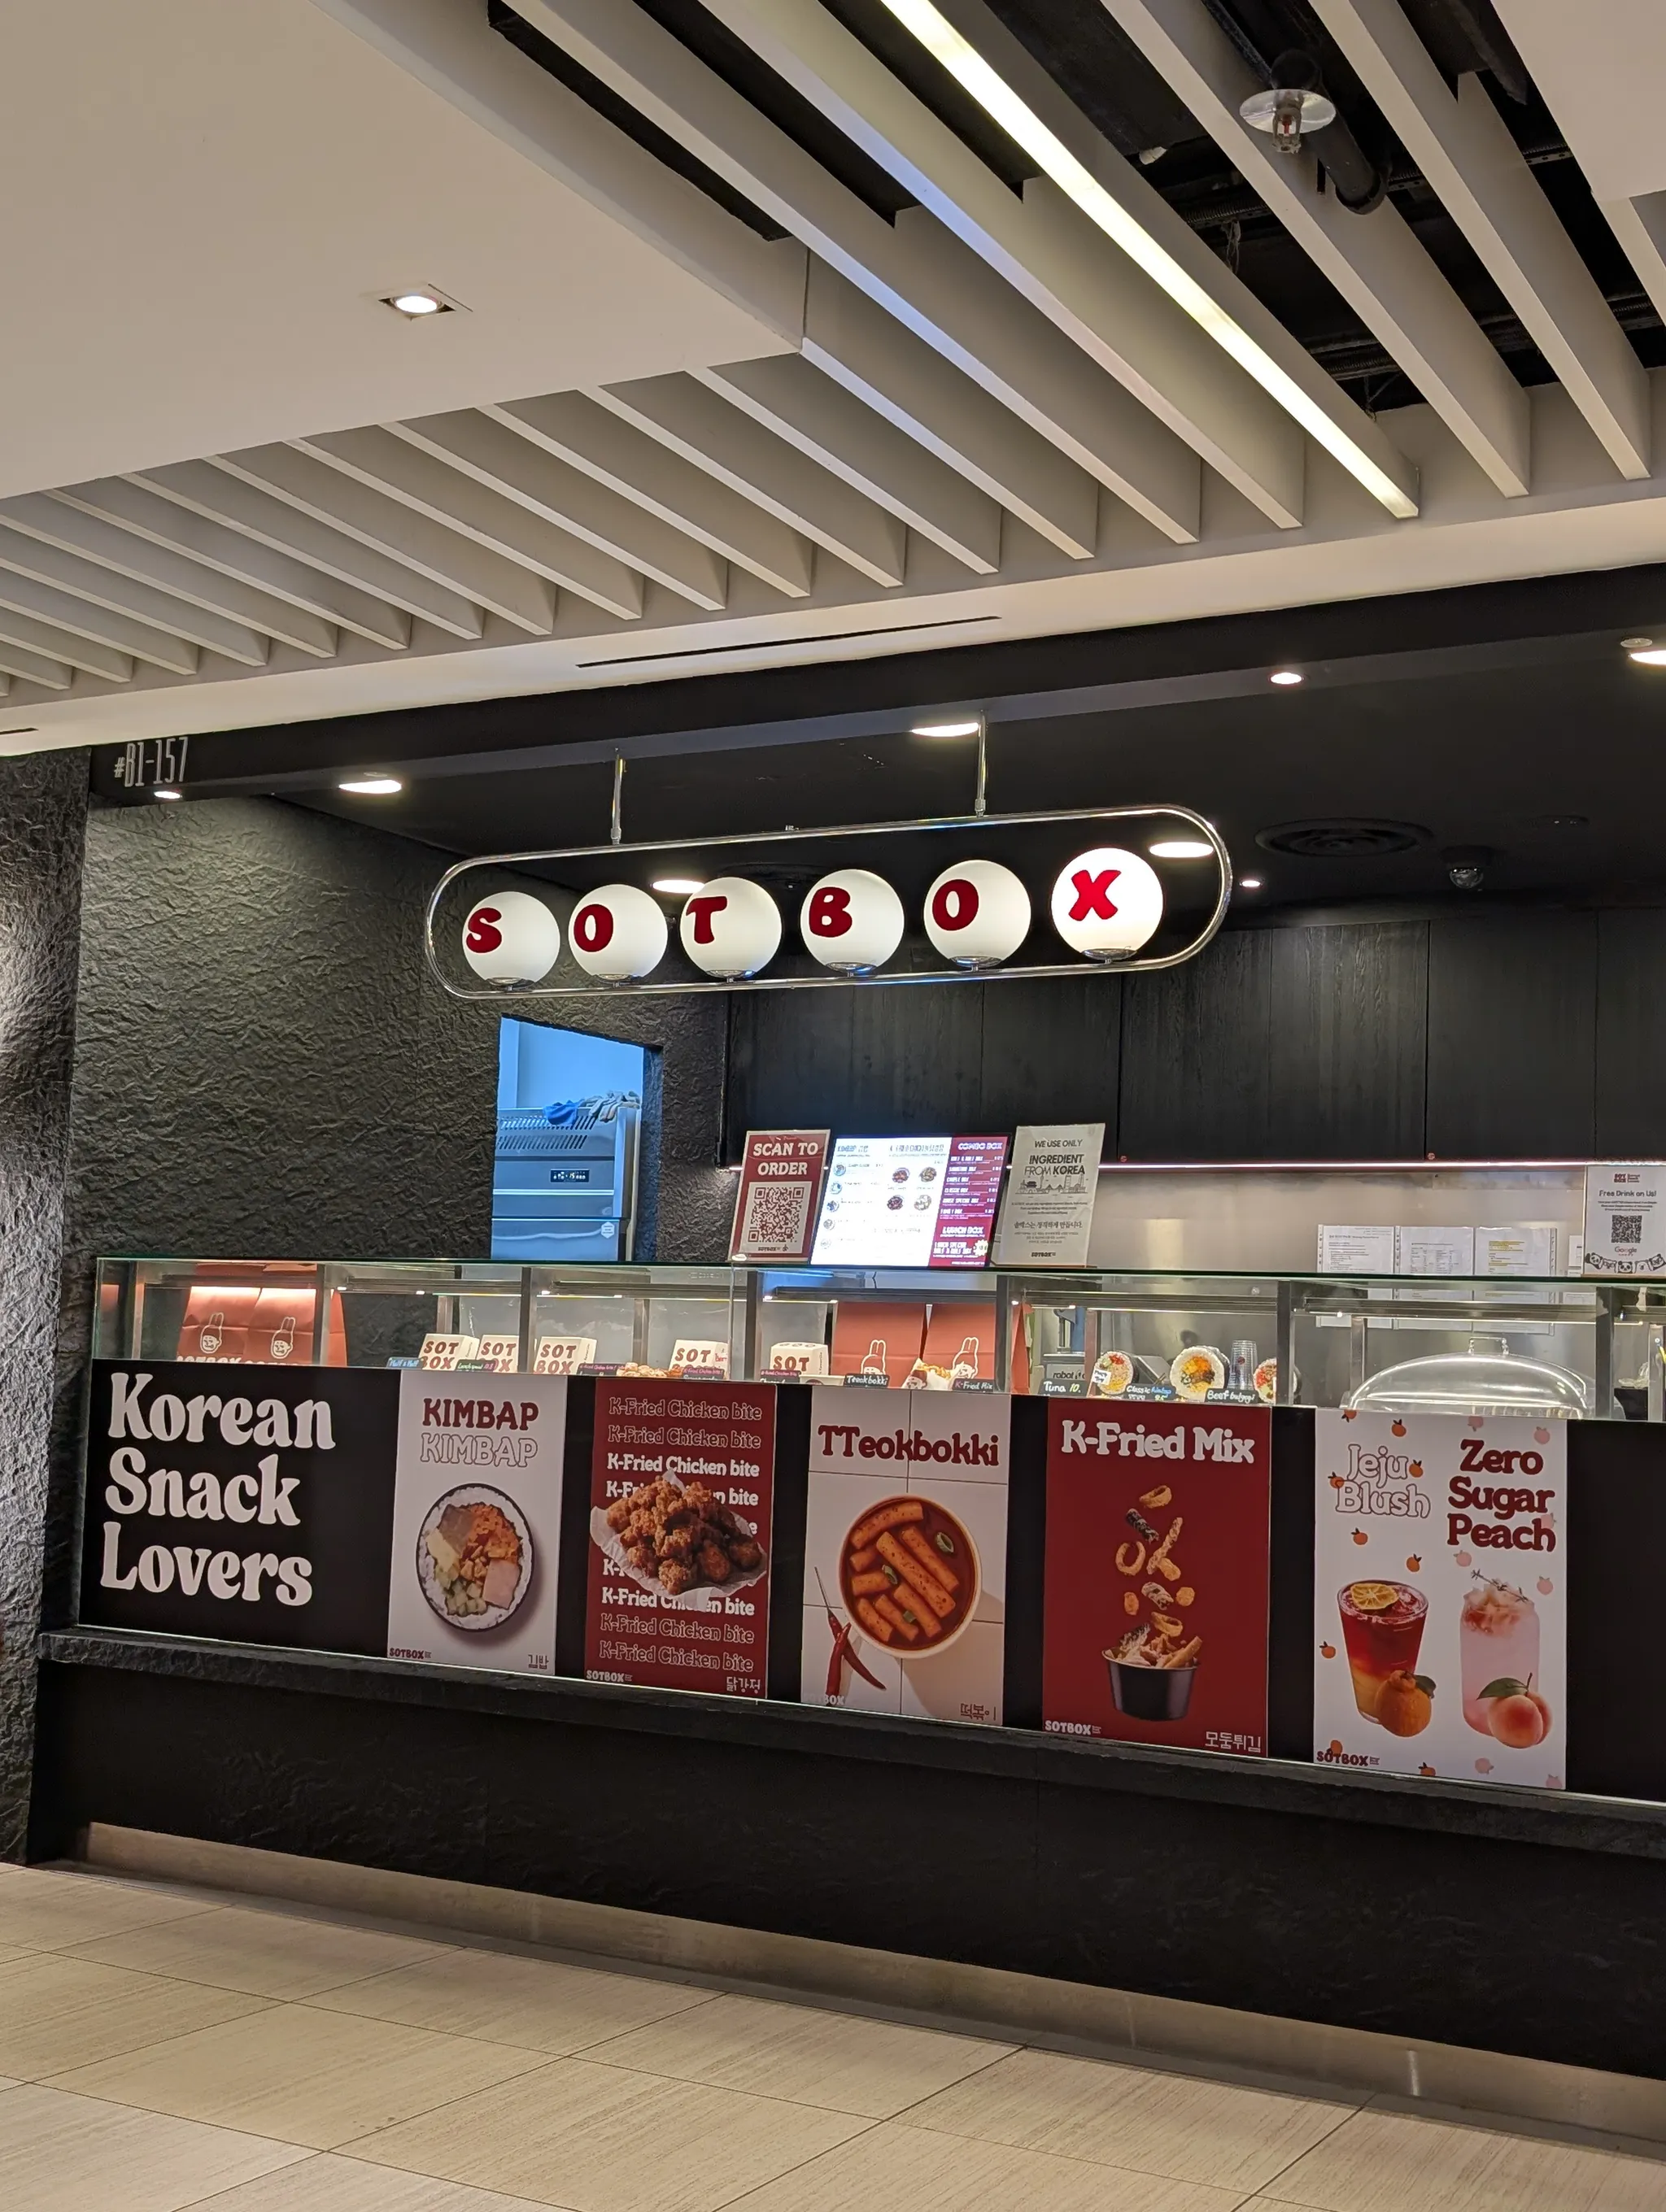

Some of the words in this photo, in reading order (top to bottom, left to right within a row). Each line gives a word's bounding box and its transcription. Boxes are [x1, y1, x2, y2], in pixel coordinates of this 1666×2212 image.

[114, 737, 188, 787] #B1-157
[753, 1143, 794, 1156] SCAN
[798, 1142, 818, 1156] TO
[1029, 1154, 1084, 1164] INGREDIENT
[757, 1162, 807, 1176] ORDER
[1025, 1166, 1051, 1175] FROM
[1053, 1165, 1085, 1174] KOREA
[1615, 1246, 1637, 1254] Google
[424, 1341, 459, 1355] SOT
[481, 1342, 517, 1356] SOT
[540, 1344, 577, 1359] SOT
[674, 1348, 711, 1363] SOT
[536, 1360, 574, 1374] BOX
[774, 1356, 809, 1372] SOT
[1053, 1371, 1074, 1379] robot
[1044, 1381, 1066, 1392] Tuna
[1127, 1385, 1150, 1394] Classic
[1207, 1390, 1229, 1400] Beef
[107, 1372, 336, 1450] Korean
[422, 1398, 539, 1430] KIMBAP
[609, 1397, 665, 1417] K-Fried
[668, 1400, 729, 1419] Chicken
[732, 1402, 762, 1421] bite
[608, 1425, 664, 1444] K-Fried
[667, 1428, 728, 1448] Chicken
[731, 1430, 761, 1449] bite
[818, 1425, 999, 1466] TTeokbokki
[1061, 1420, 1185, 1460] K-Fried
[1193, 1426, 1254, 1464] Mix
[420, 1432, 538, 1467] KIMBAP
[1460, 1439, 1543, 1475] Zero
[607, 1453, 662, 1472] K-Fried
[666, 1456, 726, 1476] Chicken
[730, 1459, 760, 1477] bite
[1347, 1444, 1409, 1488] Jeju
[105, 1447, 301, 1526] Snack
[729, 1487, 759, 1506] bite
[1336, 1479, 1431, 1518] Blush
[1448, 1476, 1555, 1520] Sugar
[1446, 1513, 1556, 1552] Peach
[100, 1521, 312, 1606] Lovers
[602, 1587, 657, 1608] K-Fried
[726, 1596, 755, 1616] bite
[600, 1613, 656, 1635] K-Fried
[660, 1618, 720, 1641] Chicken
[723, 1624, 754, 1644] bite
[390, 1648, 424, 1659] SOTBOX
[528, 1654, 549, 1670] 김밥
[600, 1640, 656, 1662] K-Fried
[658, 1646, 720, 1669] Chicken
[722, 1652, 753, 1672] bite
[587, 1670, 624, 1683] SOTBOX
[726, 1676, 761, 1694] 닭강정
[1045, 1720, 1092, 1735] SOTBOX
[1205, 1731, 1261, 1753] 모둠튀김
[1316, 1750, 1368, 1766] SOTBOX
